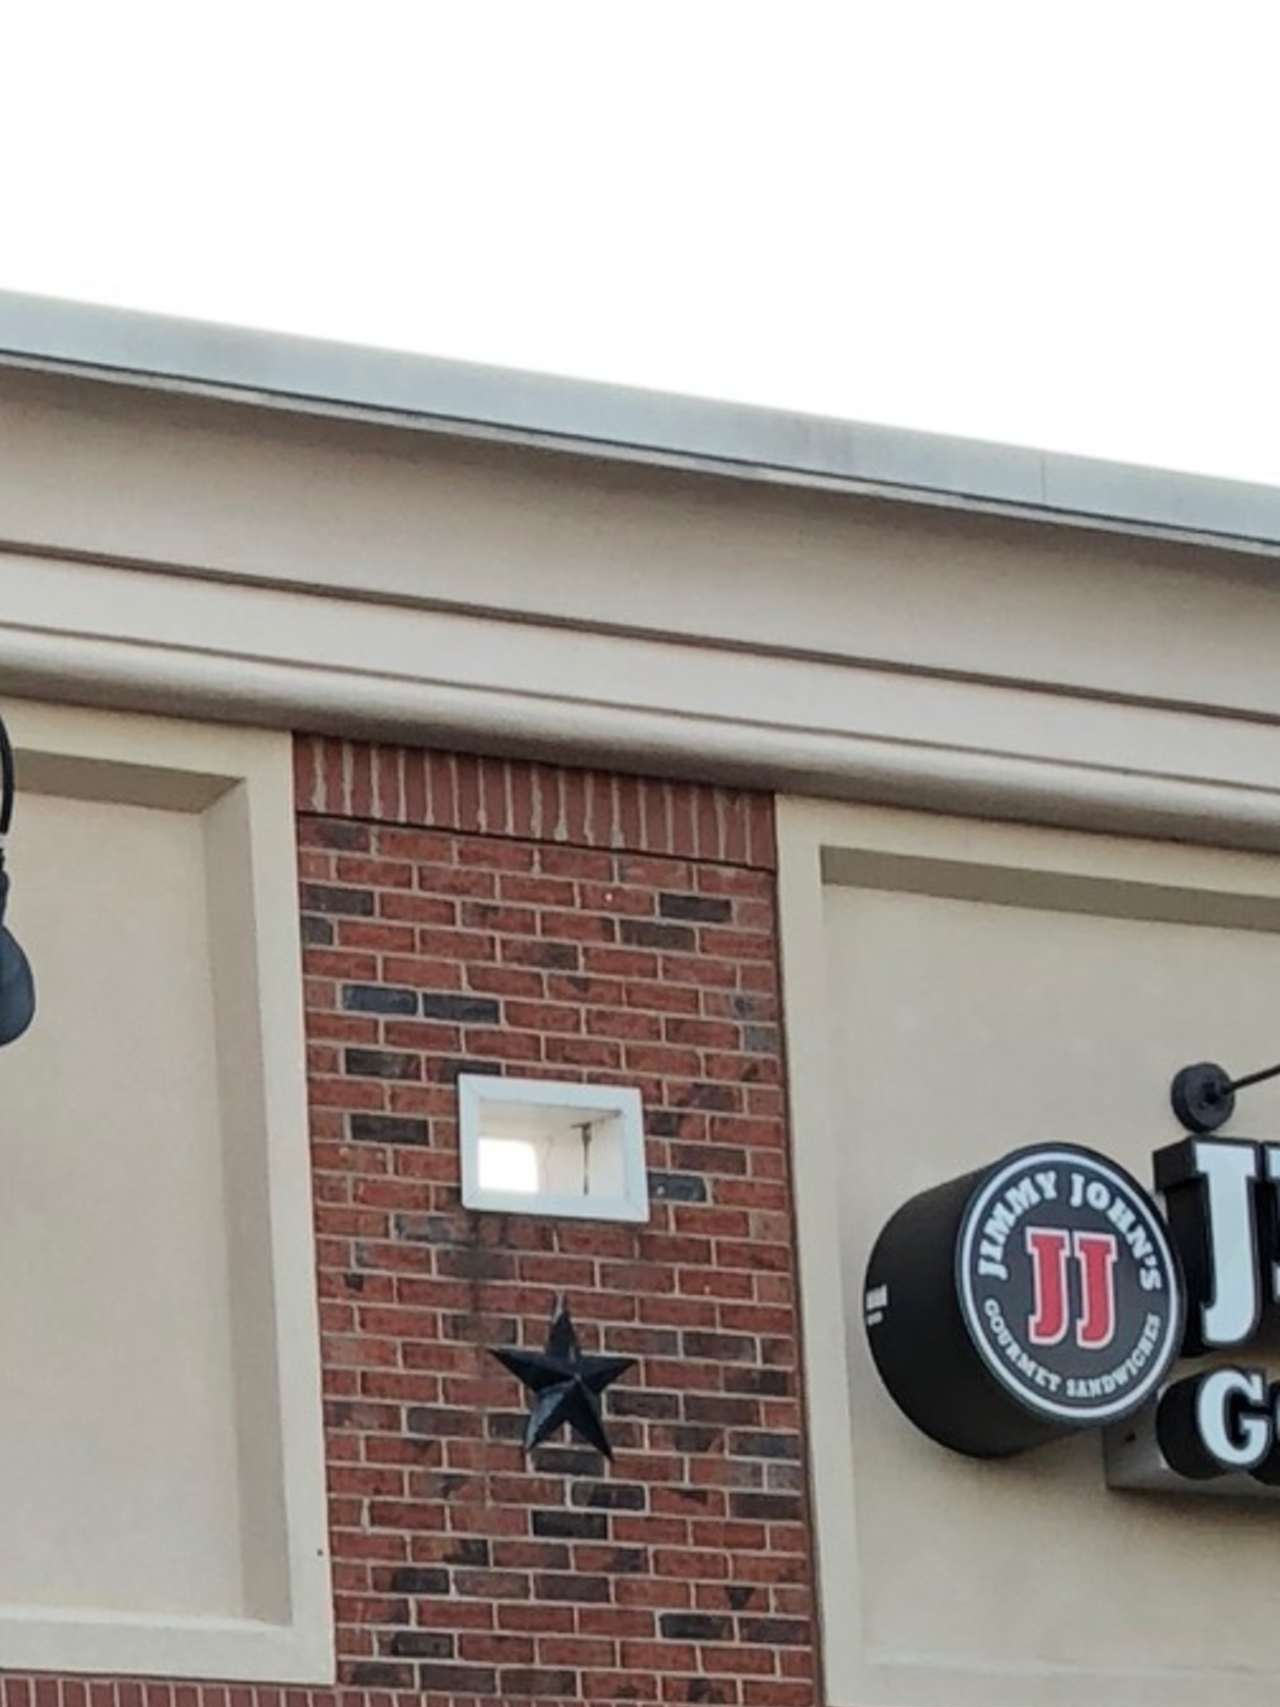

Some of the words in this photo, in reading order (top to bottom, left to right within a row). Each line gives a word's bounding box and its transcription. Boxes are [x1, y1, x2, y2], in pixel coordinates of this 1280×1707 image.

[978, 1170, 1057, 1280] JIMMY
[1069, 1172, 1162, 1291] JOHN'S
[1025, 1226, 1118, 1349] JJ
[1194, 1142, 1280, 1344] J
[984, 1298, 1062, 1392] GOURMET
[1066, 1312, 1161, 1398] SANDWICHES
[1198, 1369, 1280, 1466] G
